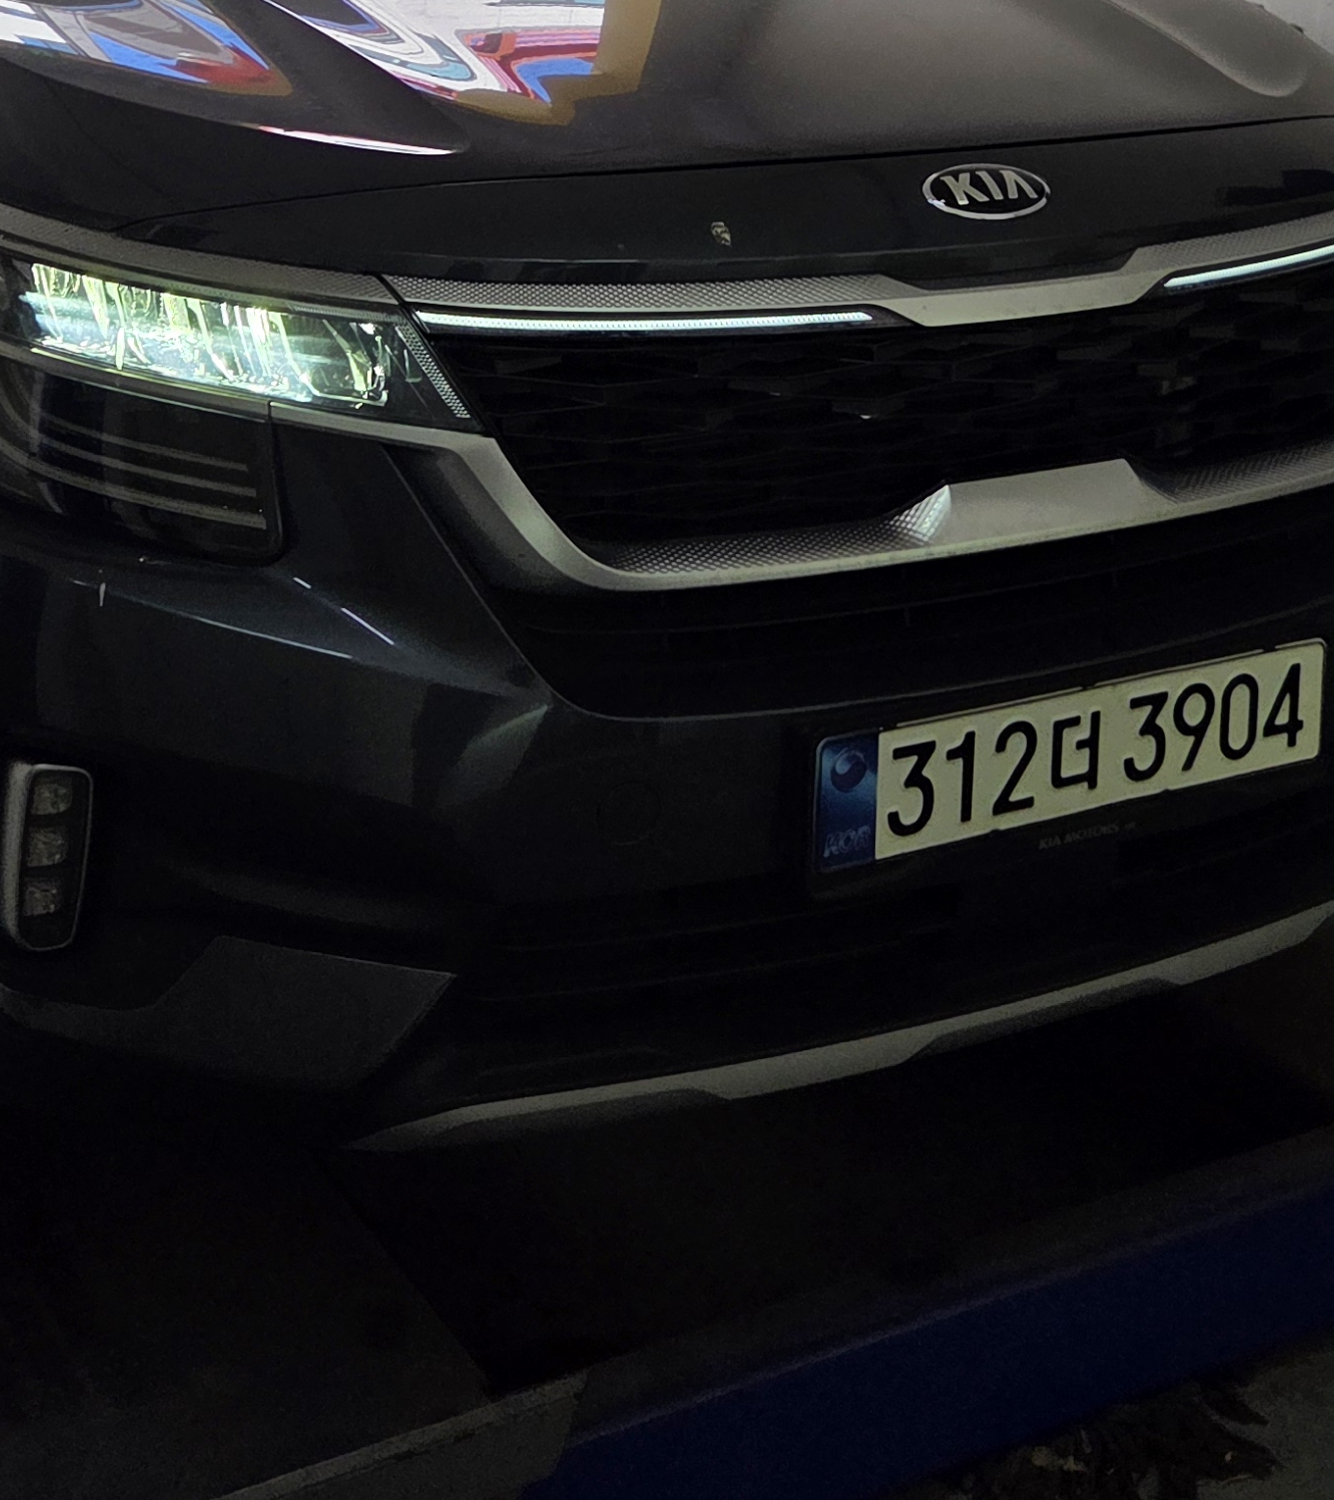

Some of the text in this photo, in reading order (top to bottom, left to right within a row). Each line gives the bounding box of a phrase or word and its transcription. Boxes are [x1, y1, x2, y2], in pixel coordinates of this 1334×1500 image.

[940, 170, 1038, 205] KIA
[887, 664, 1303, 837] 312더 3904
